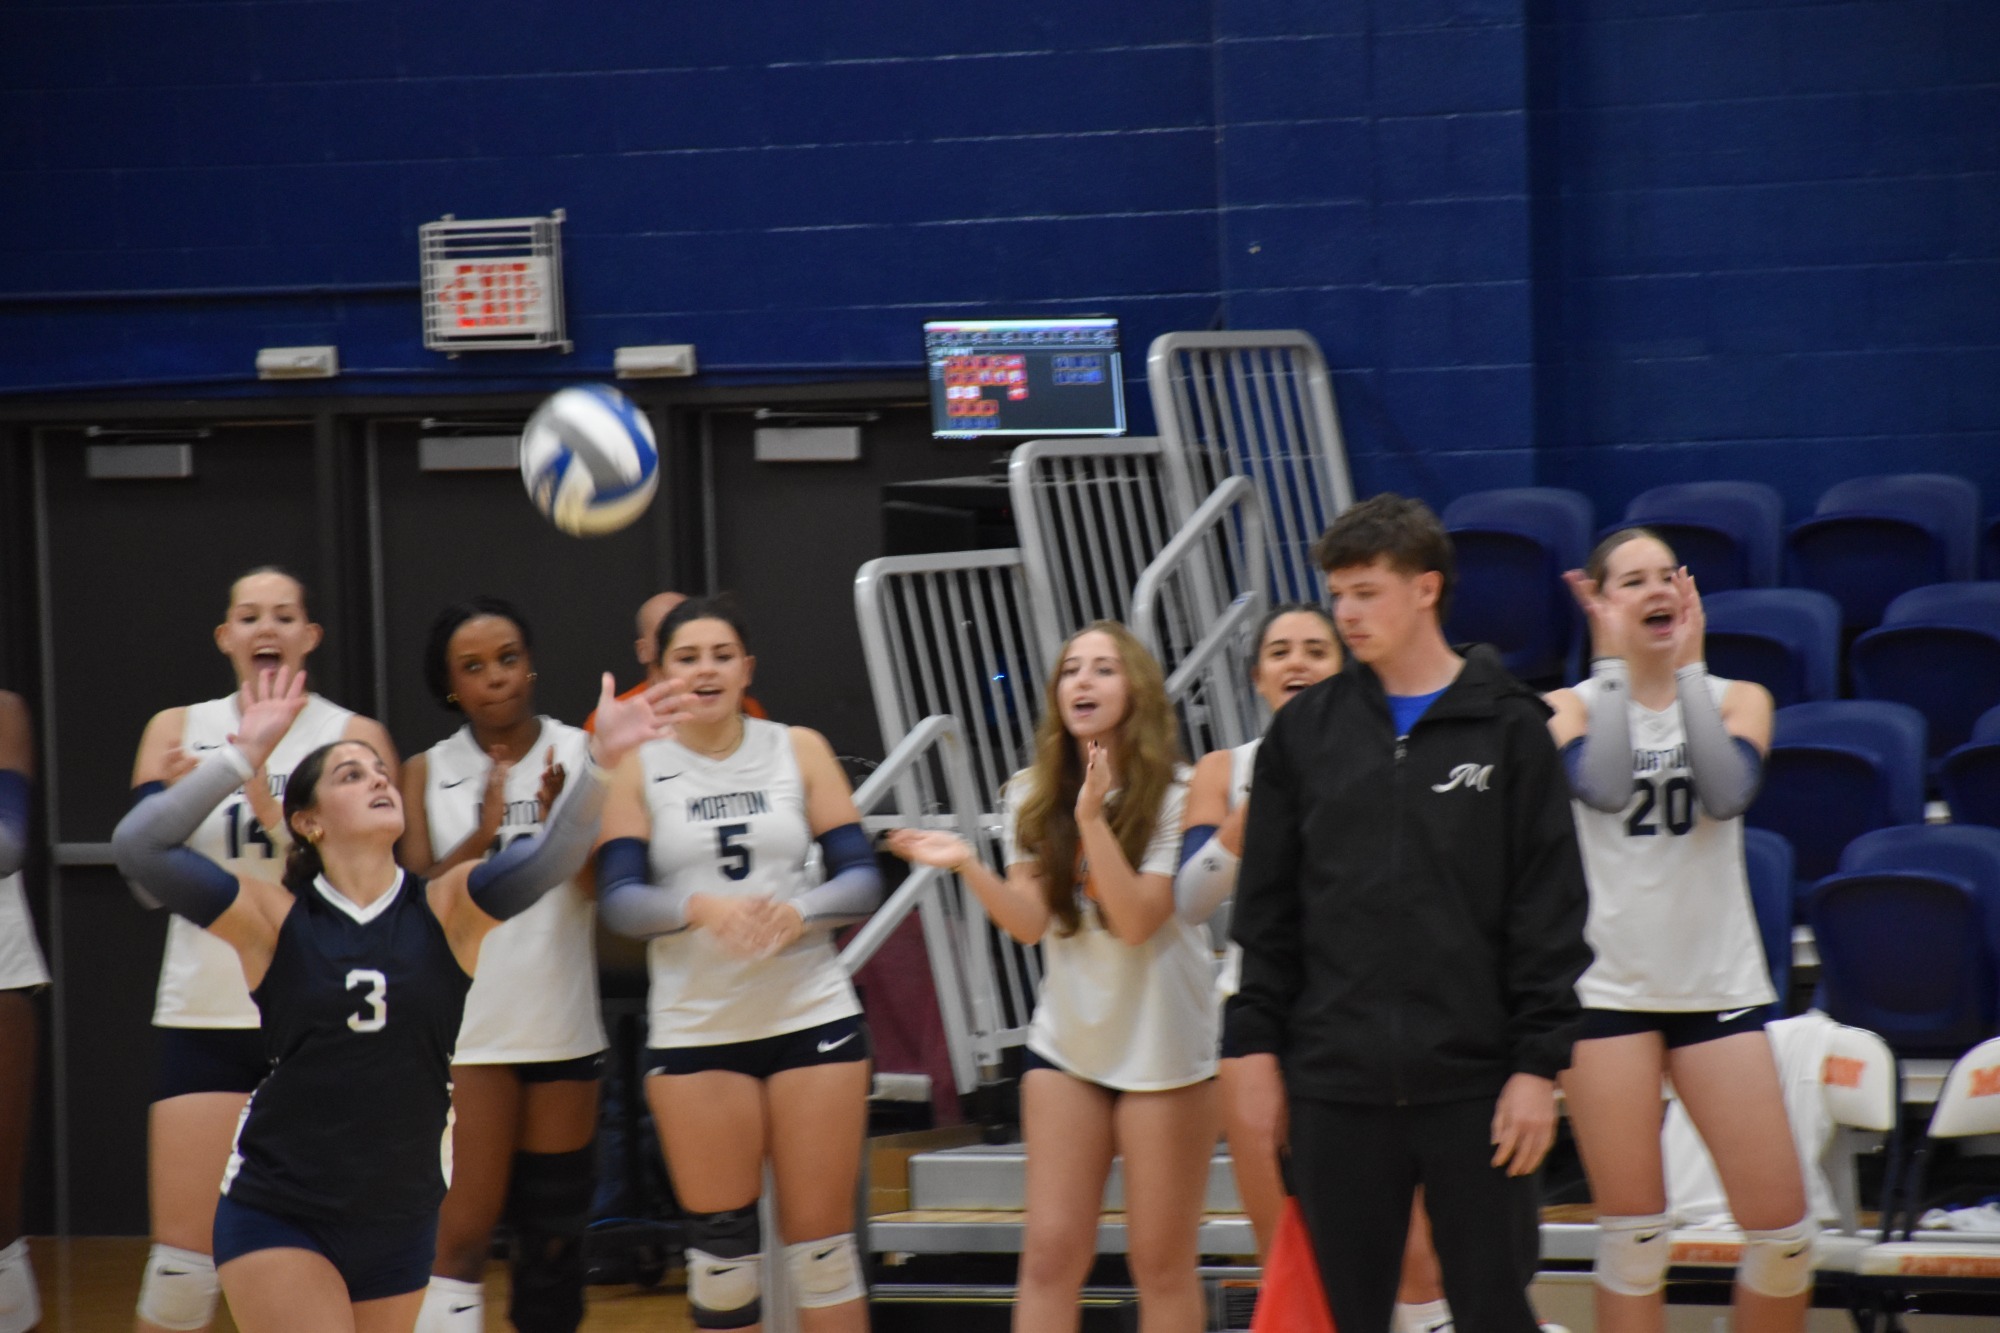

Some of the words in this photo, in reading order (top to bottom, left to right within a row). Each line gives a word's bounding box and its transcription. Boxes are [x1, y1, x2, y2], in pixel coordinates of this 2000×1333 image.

[1431, 763, 1495, 793] M
[1632, 744, 1689, 772] ORTO
[223, 801, 276, 859] 14
[685, 790, 772, 822] MORTON
[1624, 776, 1694, 836] 20
[716, 822, 751, 881] 5
[345, 968, 387, 1033] 3
